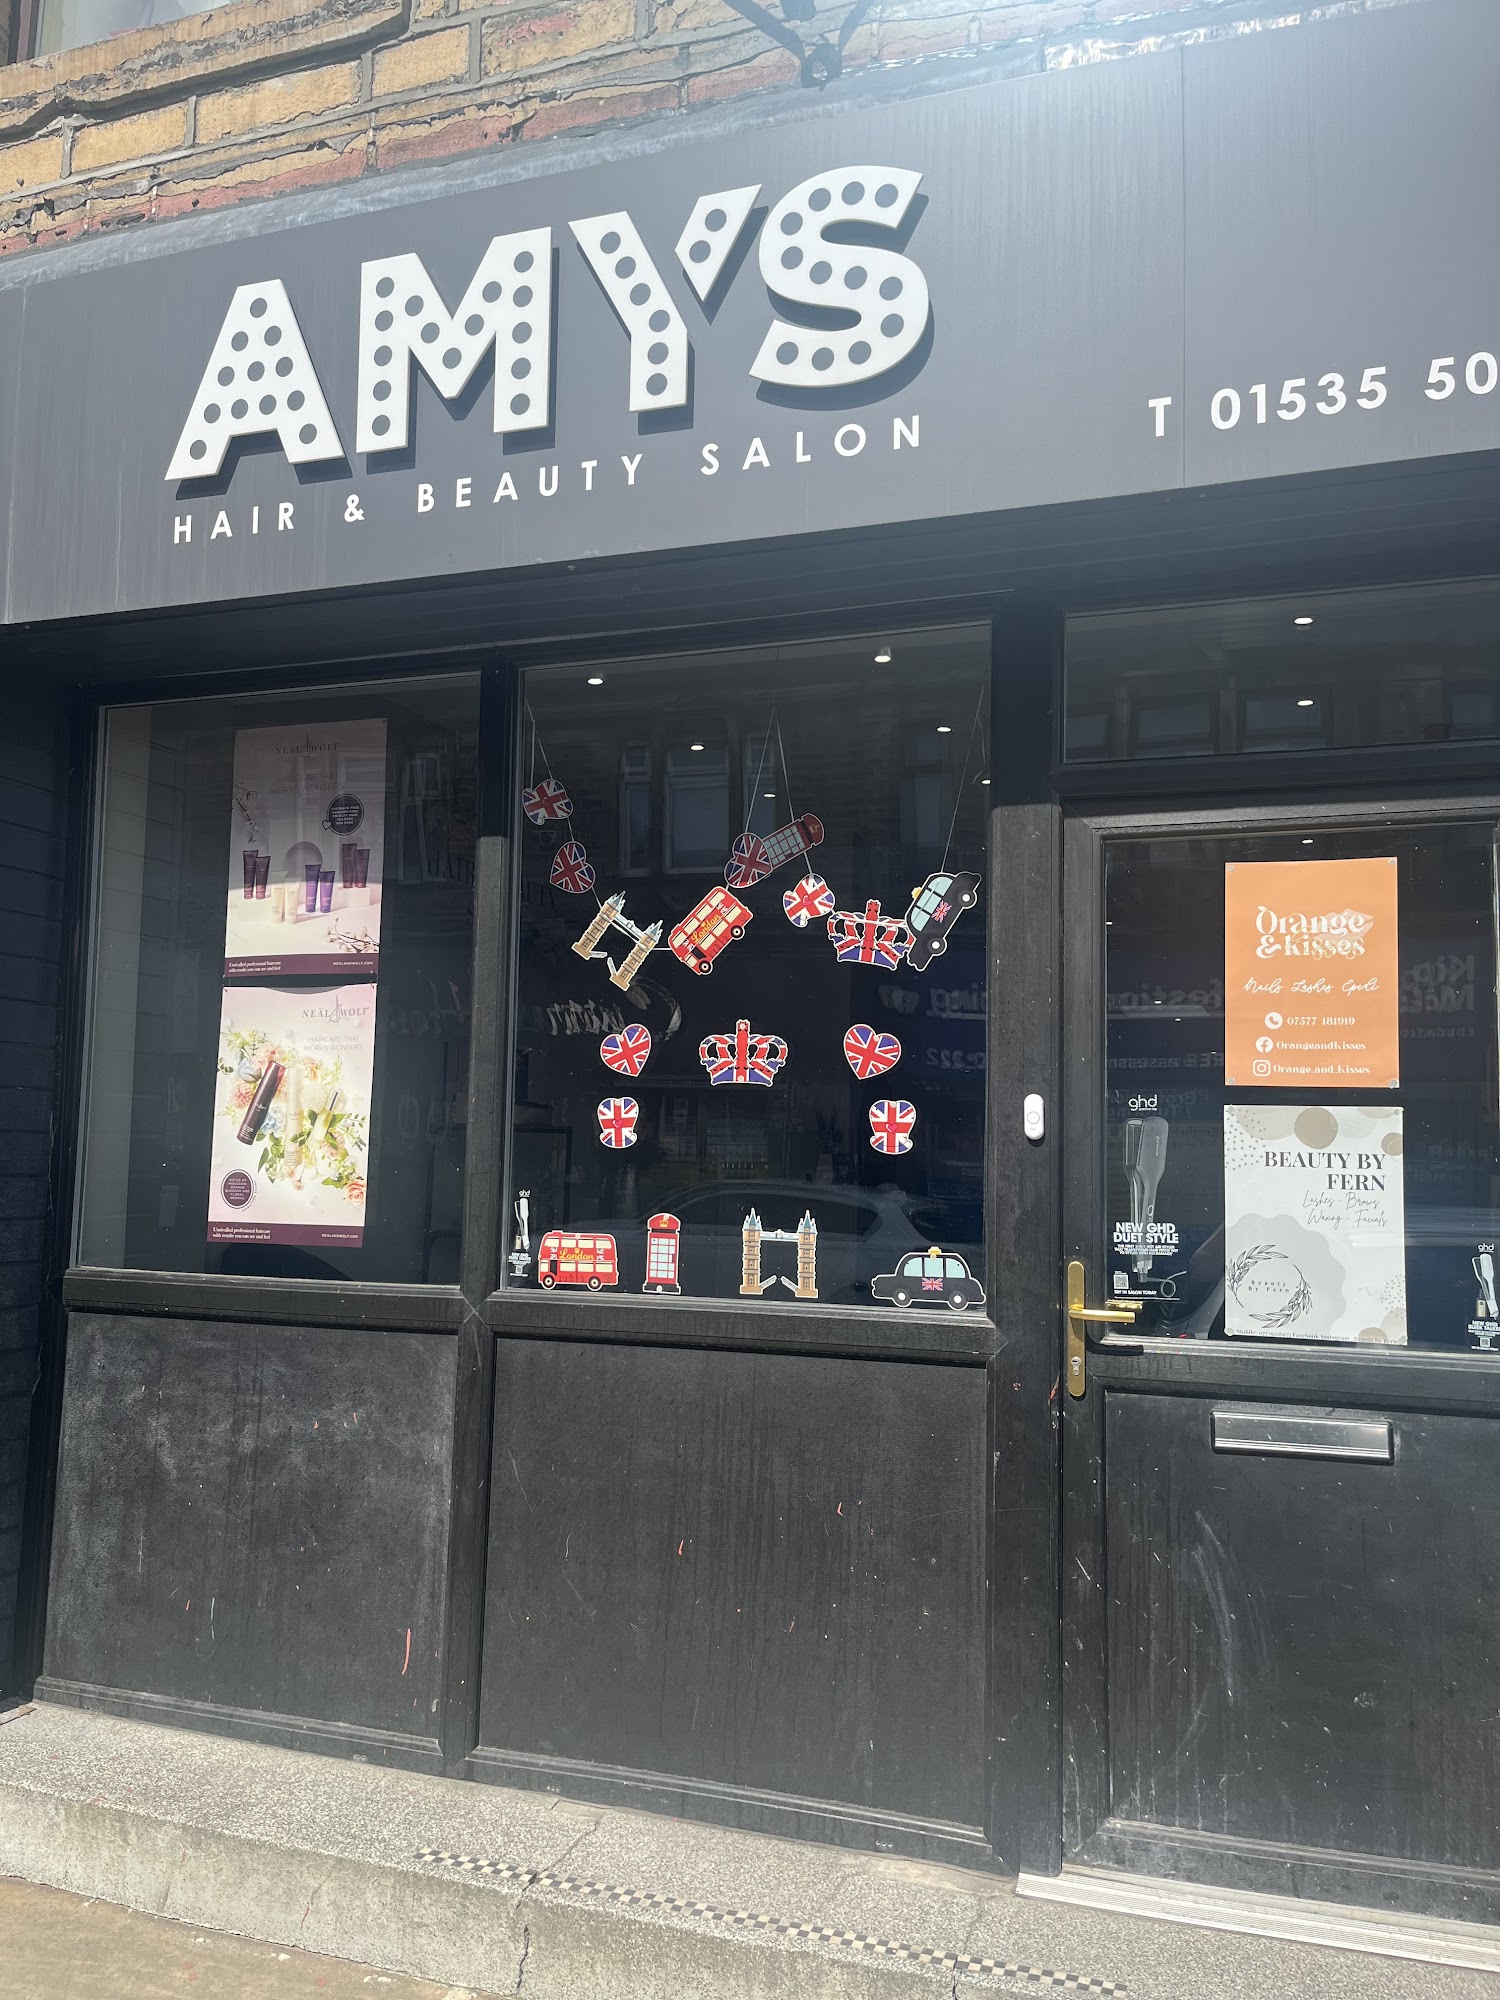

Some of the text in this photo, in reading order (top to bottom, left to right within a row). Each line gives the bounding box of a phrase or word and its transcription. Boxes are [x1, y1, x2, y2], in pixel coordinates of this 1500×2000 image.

[1148, 396, 1172, 437] T
[1210, 366, 1388, 430] 01535
[173, 414, 919, 544] HAIR & BEAUTY SALON
[690, 913, 720, 943] London
[1255, 905, 1365, 936] Orange
[1243, 976, 1283, 994] Nails
[340, 1006, 369, 1017] WOLF
[1286, 1016, 1317, 1026] 07577
[1128, 1094, 1158, 1111] ghd
[1264, 1150, 1386, 1170] BEAUTY BY
[1326, 1173, 1387, 1191] FERN
[1346, 1191, 1380, 1210] Brows
[1115, 1222, 1176, 1233] NEW GHD
[1113, 1232, 1180, 1243] DUET STYLE
[559, 1249, 594, 1260] London
[1477, 1243, 1495, 1253] ghd
